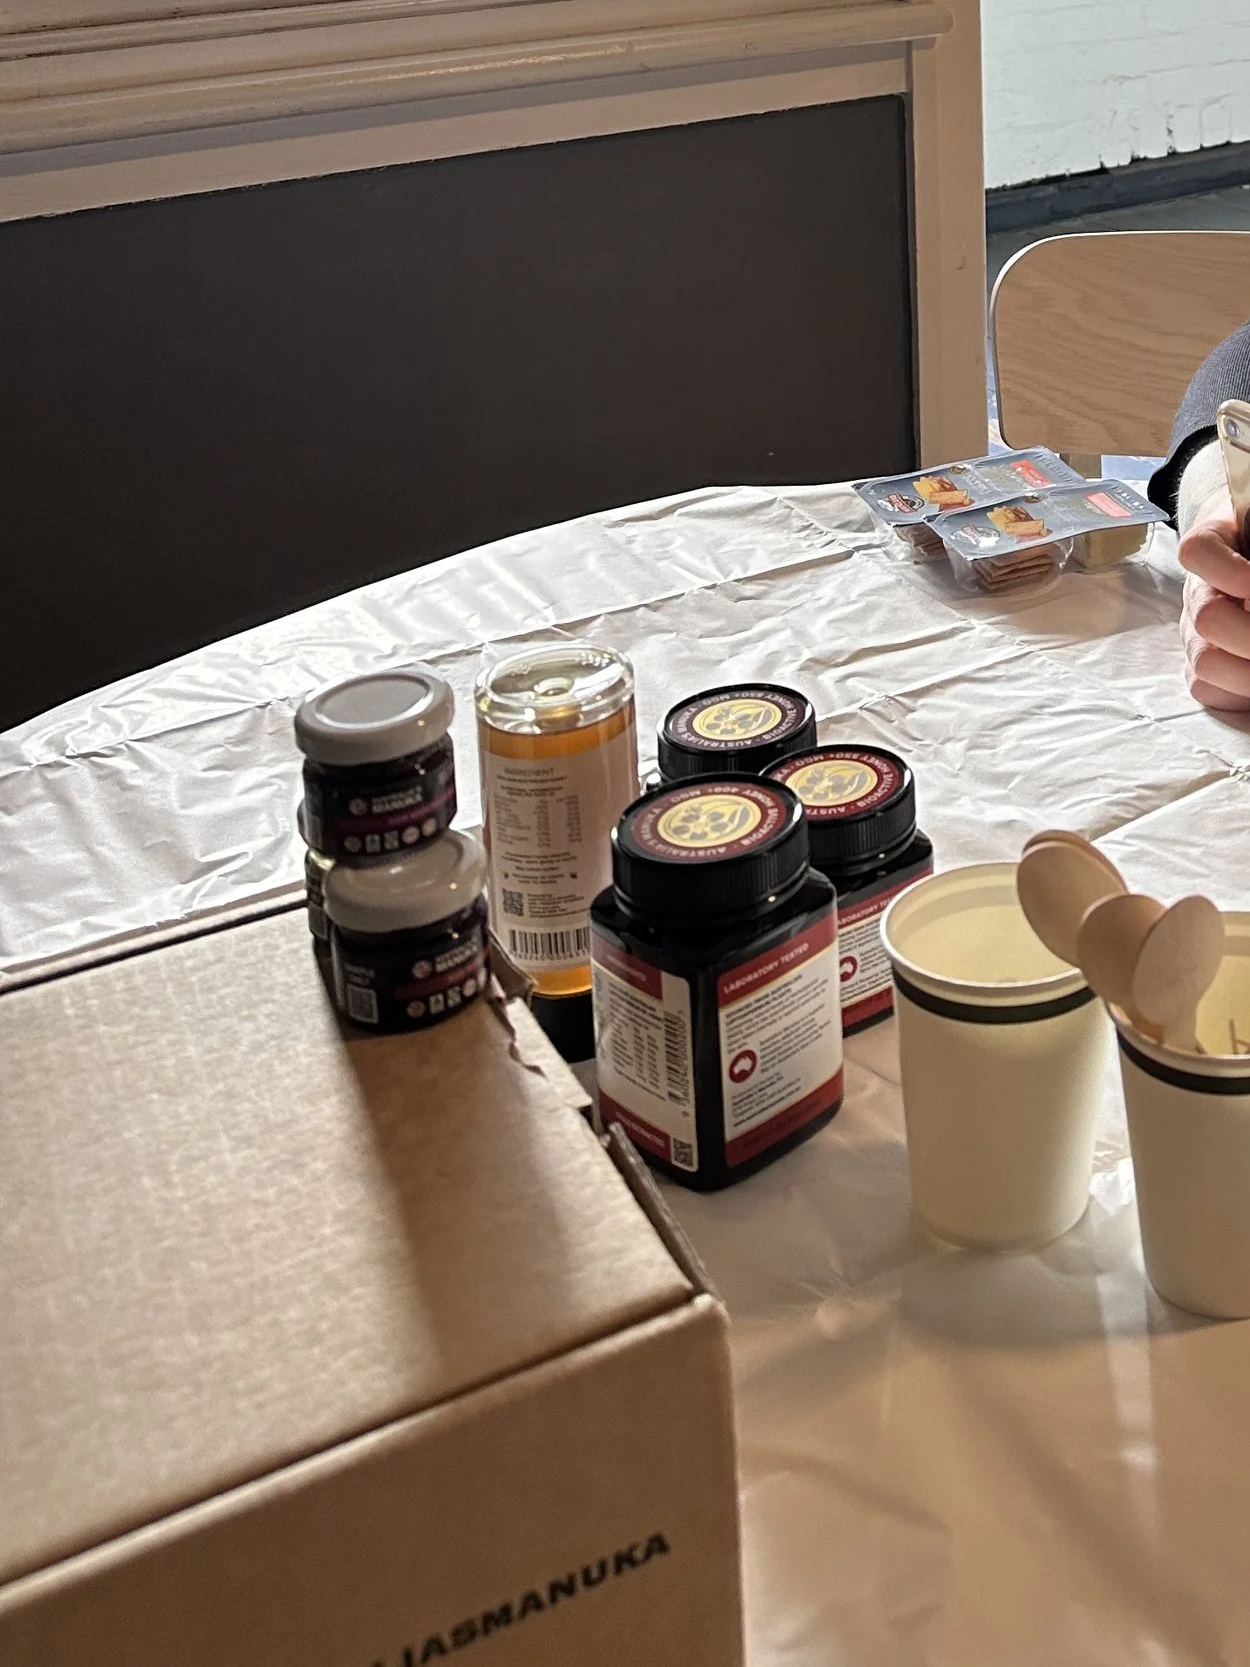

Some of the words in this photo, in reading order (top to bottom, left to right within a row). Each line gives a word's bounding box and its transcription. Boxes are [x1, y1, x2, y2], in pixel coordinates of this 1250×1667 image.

[838, 902, 879, 926] ABORATORY
[724, 961, 779, 994] LABORATORY
[781, 943, 809, 964] TESTED
[370, 1531, 672, 1667] IASMANUKA
